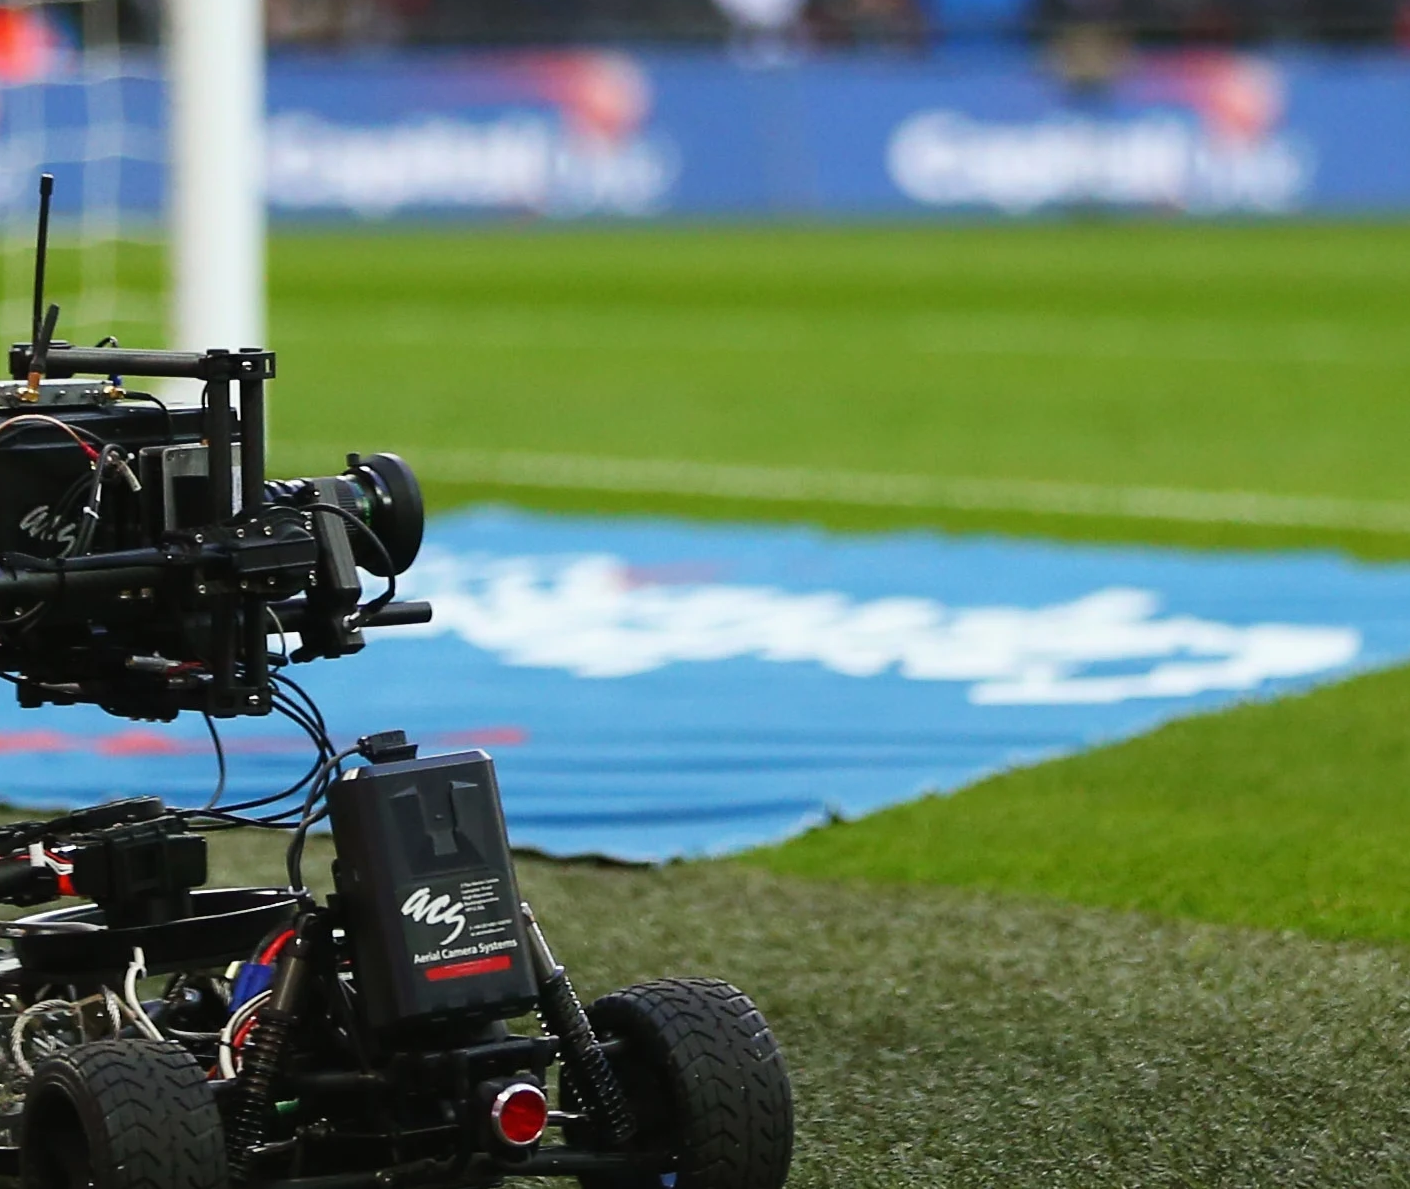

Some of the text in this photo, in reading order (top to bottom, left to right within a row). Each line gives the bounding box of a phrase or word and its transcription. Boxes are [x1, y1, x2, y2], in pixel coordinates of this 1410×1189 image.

[402, 888, 465, 945] acs
[415, 940, 517, 963] Aerial Camera Systems
